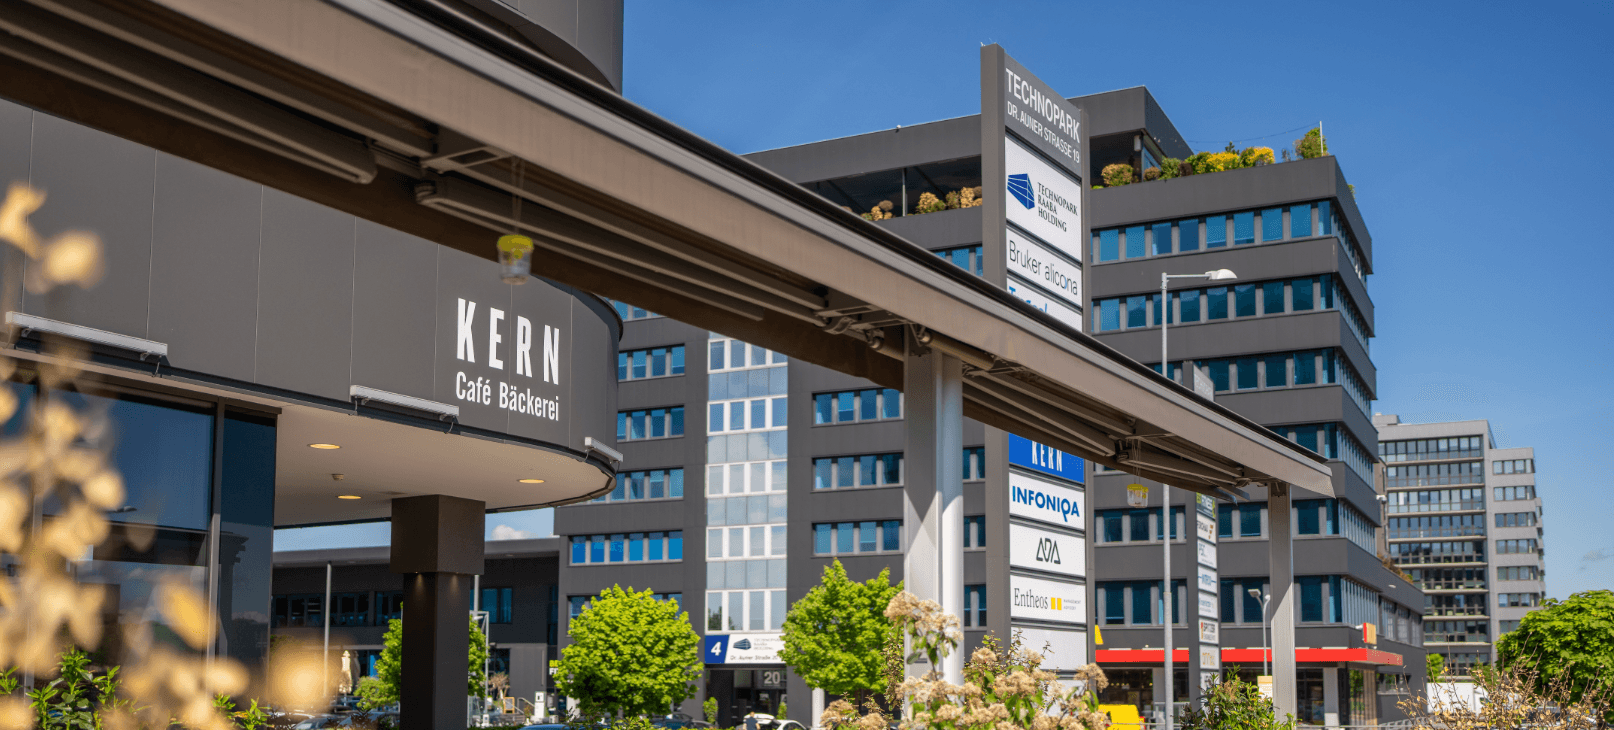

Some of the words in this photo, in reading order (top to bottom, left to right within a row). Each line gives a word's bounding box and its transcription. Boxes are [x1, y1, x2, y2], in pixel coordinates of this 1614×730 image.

[1005, 67, 1080, 143] TECHNOPARK
[1008, 101, 1020, 121] DR.
[1020, 111, 1043, 137] AUNER
[1044, 127, 1072, 158] STRASSE
[1073, 138, 1080, 163] 19
[1037, 182, 1078, 216] TECHNOPARK
[1038, 195, 1058, 215] RAABA
[1038, 208, 1067, 232] HOLDING
[1009, 240, 1041, 275] Bruker
[1045, 263, 1078, 295] alicona
[457, 298, 560, 385] KERN
[456, 371, 492, 405] Café
[499, 381, 559, 421] Bäckerei
[1012, 485, 1080, 522] INFONIQA
[1014, 587, 1049, 609] Entheos
[710, 641, 722, 656] 4
[763, 671, 780, 685] 20
